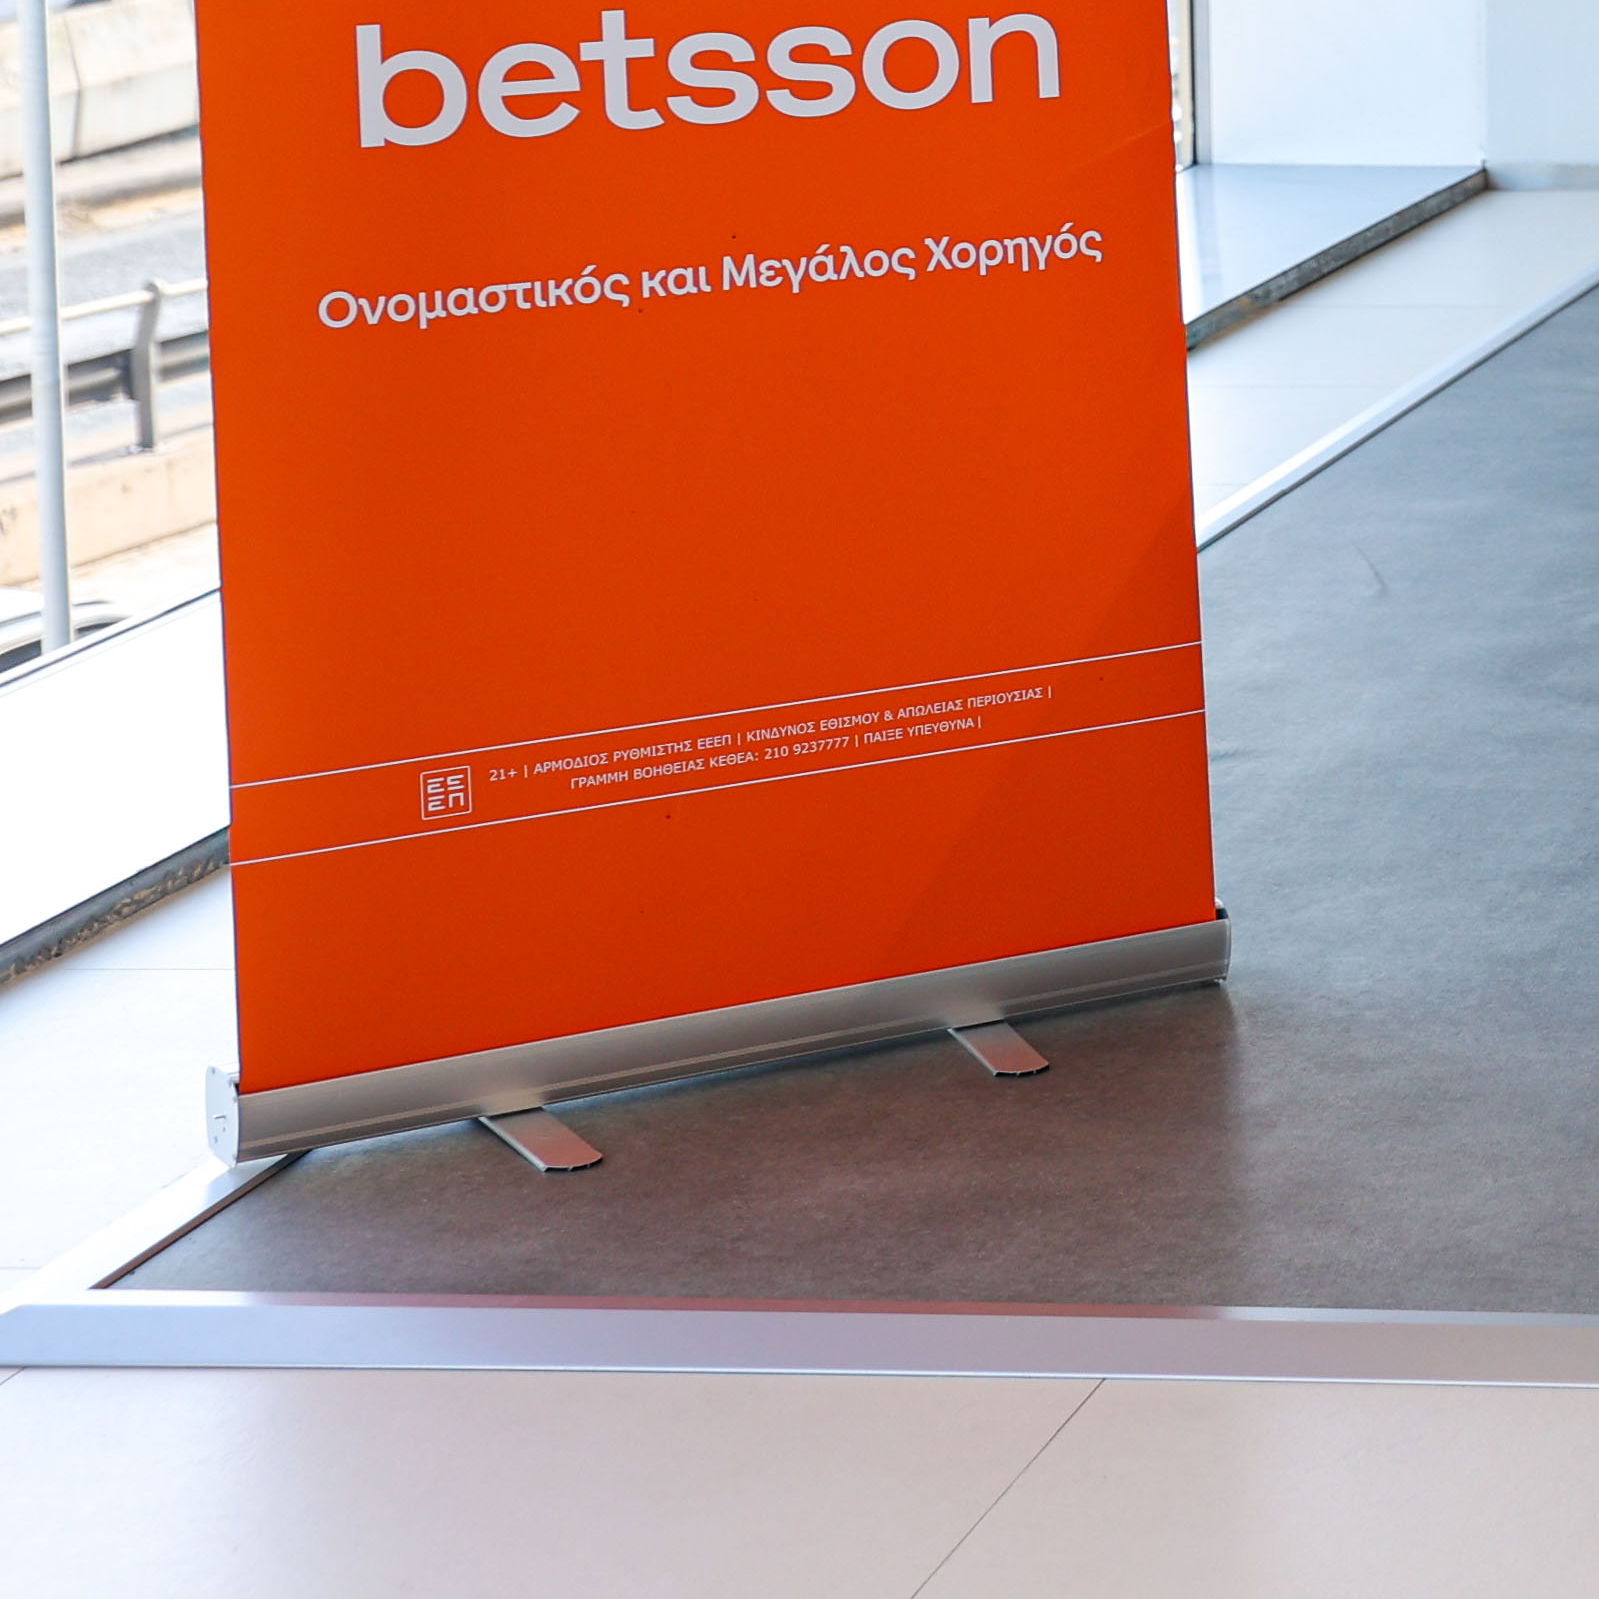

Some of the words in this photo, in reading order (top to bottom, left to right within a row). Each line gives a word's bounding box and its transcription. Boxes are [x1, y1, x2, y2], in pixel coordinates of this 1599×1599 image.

[356, 10, 1059, 147] betsson
[319, 265, 629, 329] Ονομαστικός
[642, 267, 711, 298] και
[723, 244, 915, 293] Μεγάλος
[925, 223, 1102, 275] Χορηγός
[490, 769, 517, 781] 21+
[534, 753, 608, 774] ΑΡΜΟΔΙΟΣ
[614, 740, 692, 761] ΡΥΘΜΙΣΤΗΣ
[698, 735, 731, 749] ΕΕΕΠ
[747, 722, 815, 741] ΚΙΝΔΥΝΟΣ
[821, 713, 879, 730] ΕΘΙΣΜΟΥ
[884, 711, 893, 720] &
[898, 700, 962, 718] ΑΠΩΛΕΙΑΣ
[968, 688, 1042, 707] ΠΕΡΙΟΥΣΙΑΣ
[572, 771, 628, 788] ΓΡΑΜΜΗ
[634, 759, 704, 779] ΒΟΗΘΕΙΑΣ
[709, 751, 759, 768] ΚΕΘΕΑ:
[765, 746, 788, 759] 210
[793, 737, 849, 754] 9237777
[864, 729, 902, 743] ΠΑΙΞΕ
[908, 718, 974, 736] ΥΠΕΥΘΥΝΑ
